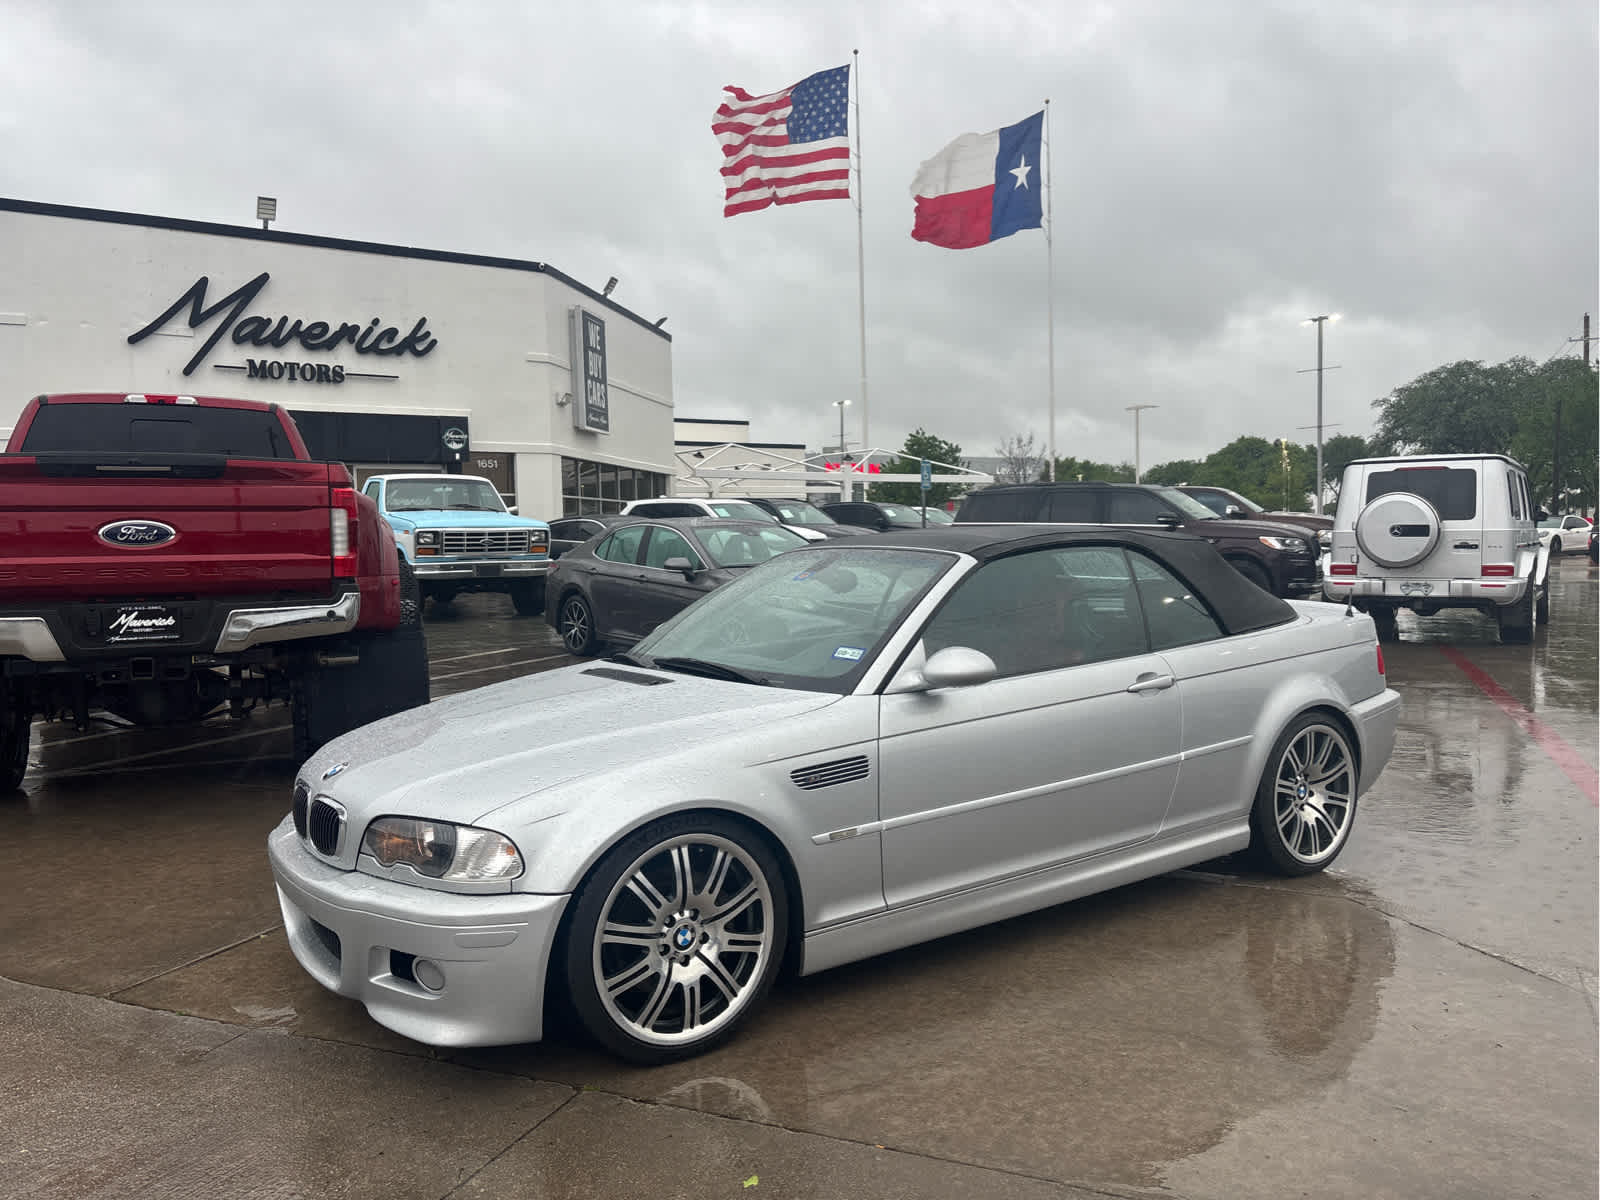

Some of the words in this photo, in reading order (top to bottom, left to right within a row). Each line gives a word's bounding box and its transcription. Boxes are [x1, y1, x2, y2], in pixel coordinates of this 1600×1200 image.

[127, 272, 437, 376] Maverick
[587, 319, 601, 350] WE
[246, 358, 345, 383] MOTORS
[587, 350, 602, 379] BUY
[587, 379, 606, 408] CARS
[477, 459, 498, 468] 1651
[117, 525, 158, 541] Ford
